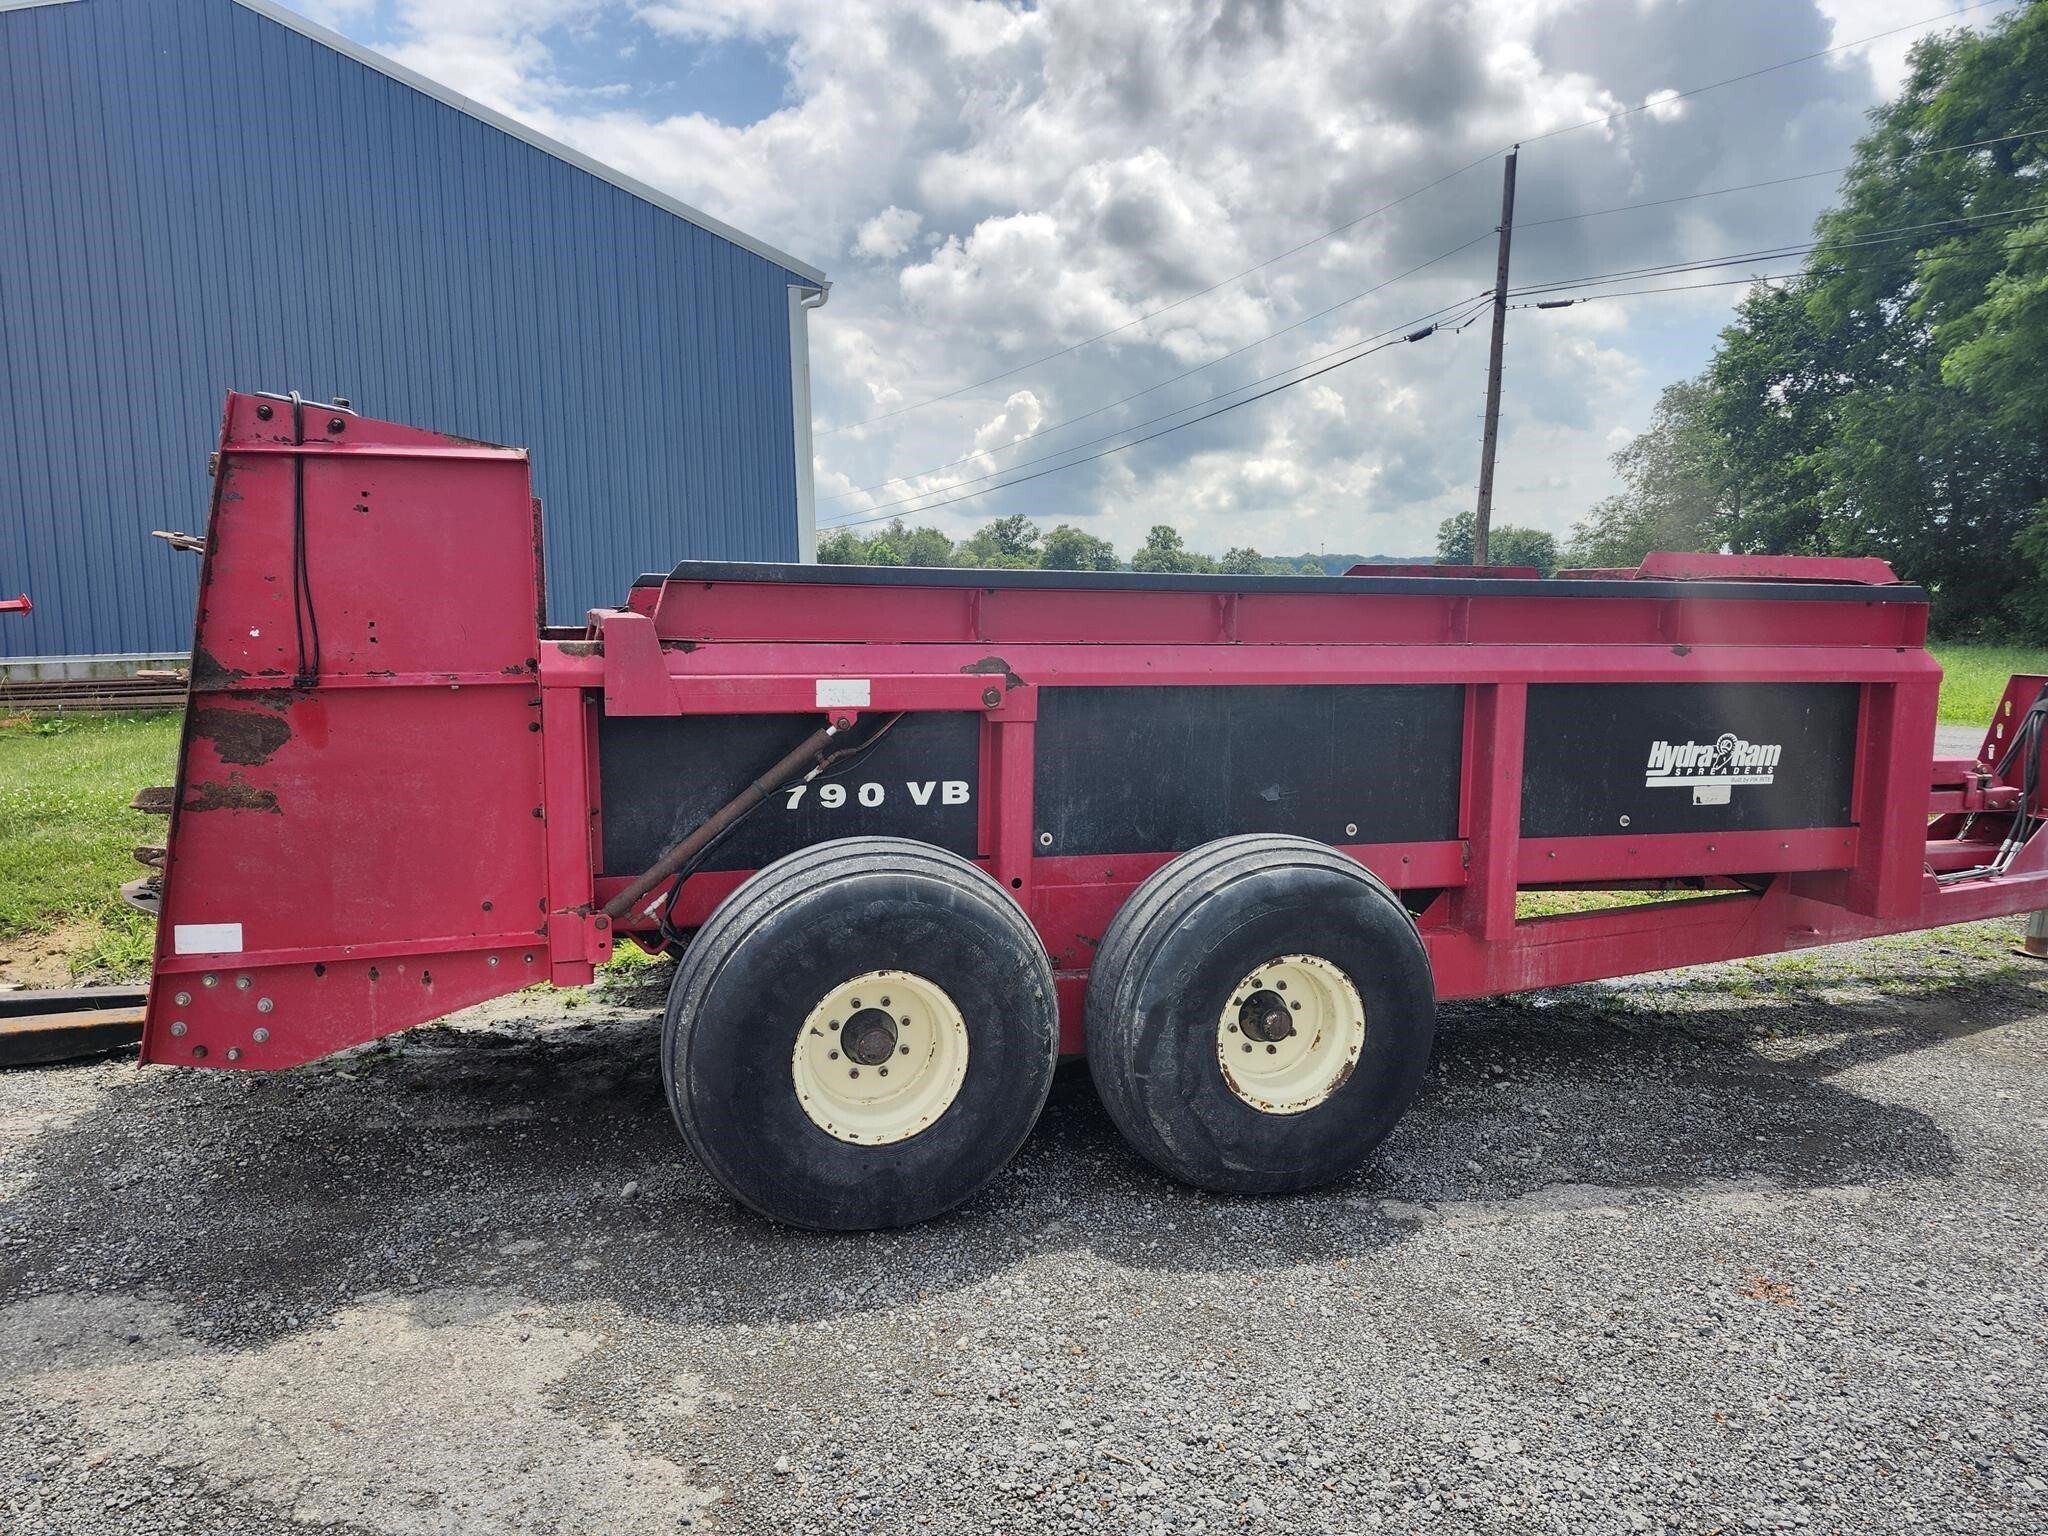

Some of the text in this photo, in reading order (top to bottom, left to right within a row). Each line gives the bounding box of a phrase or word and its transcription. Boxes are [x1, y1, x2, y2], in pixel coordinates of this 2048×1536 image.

[1730, 740, 1782, 767] Ram
[1674, 766, 1774, 777] SPREADERS
[785, 780, 970, 810] 790 VB
